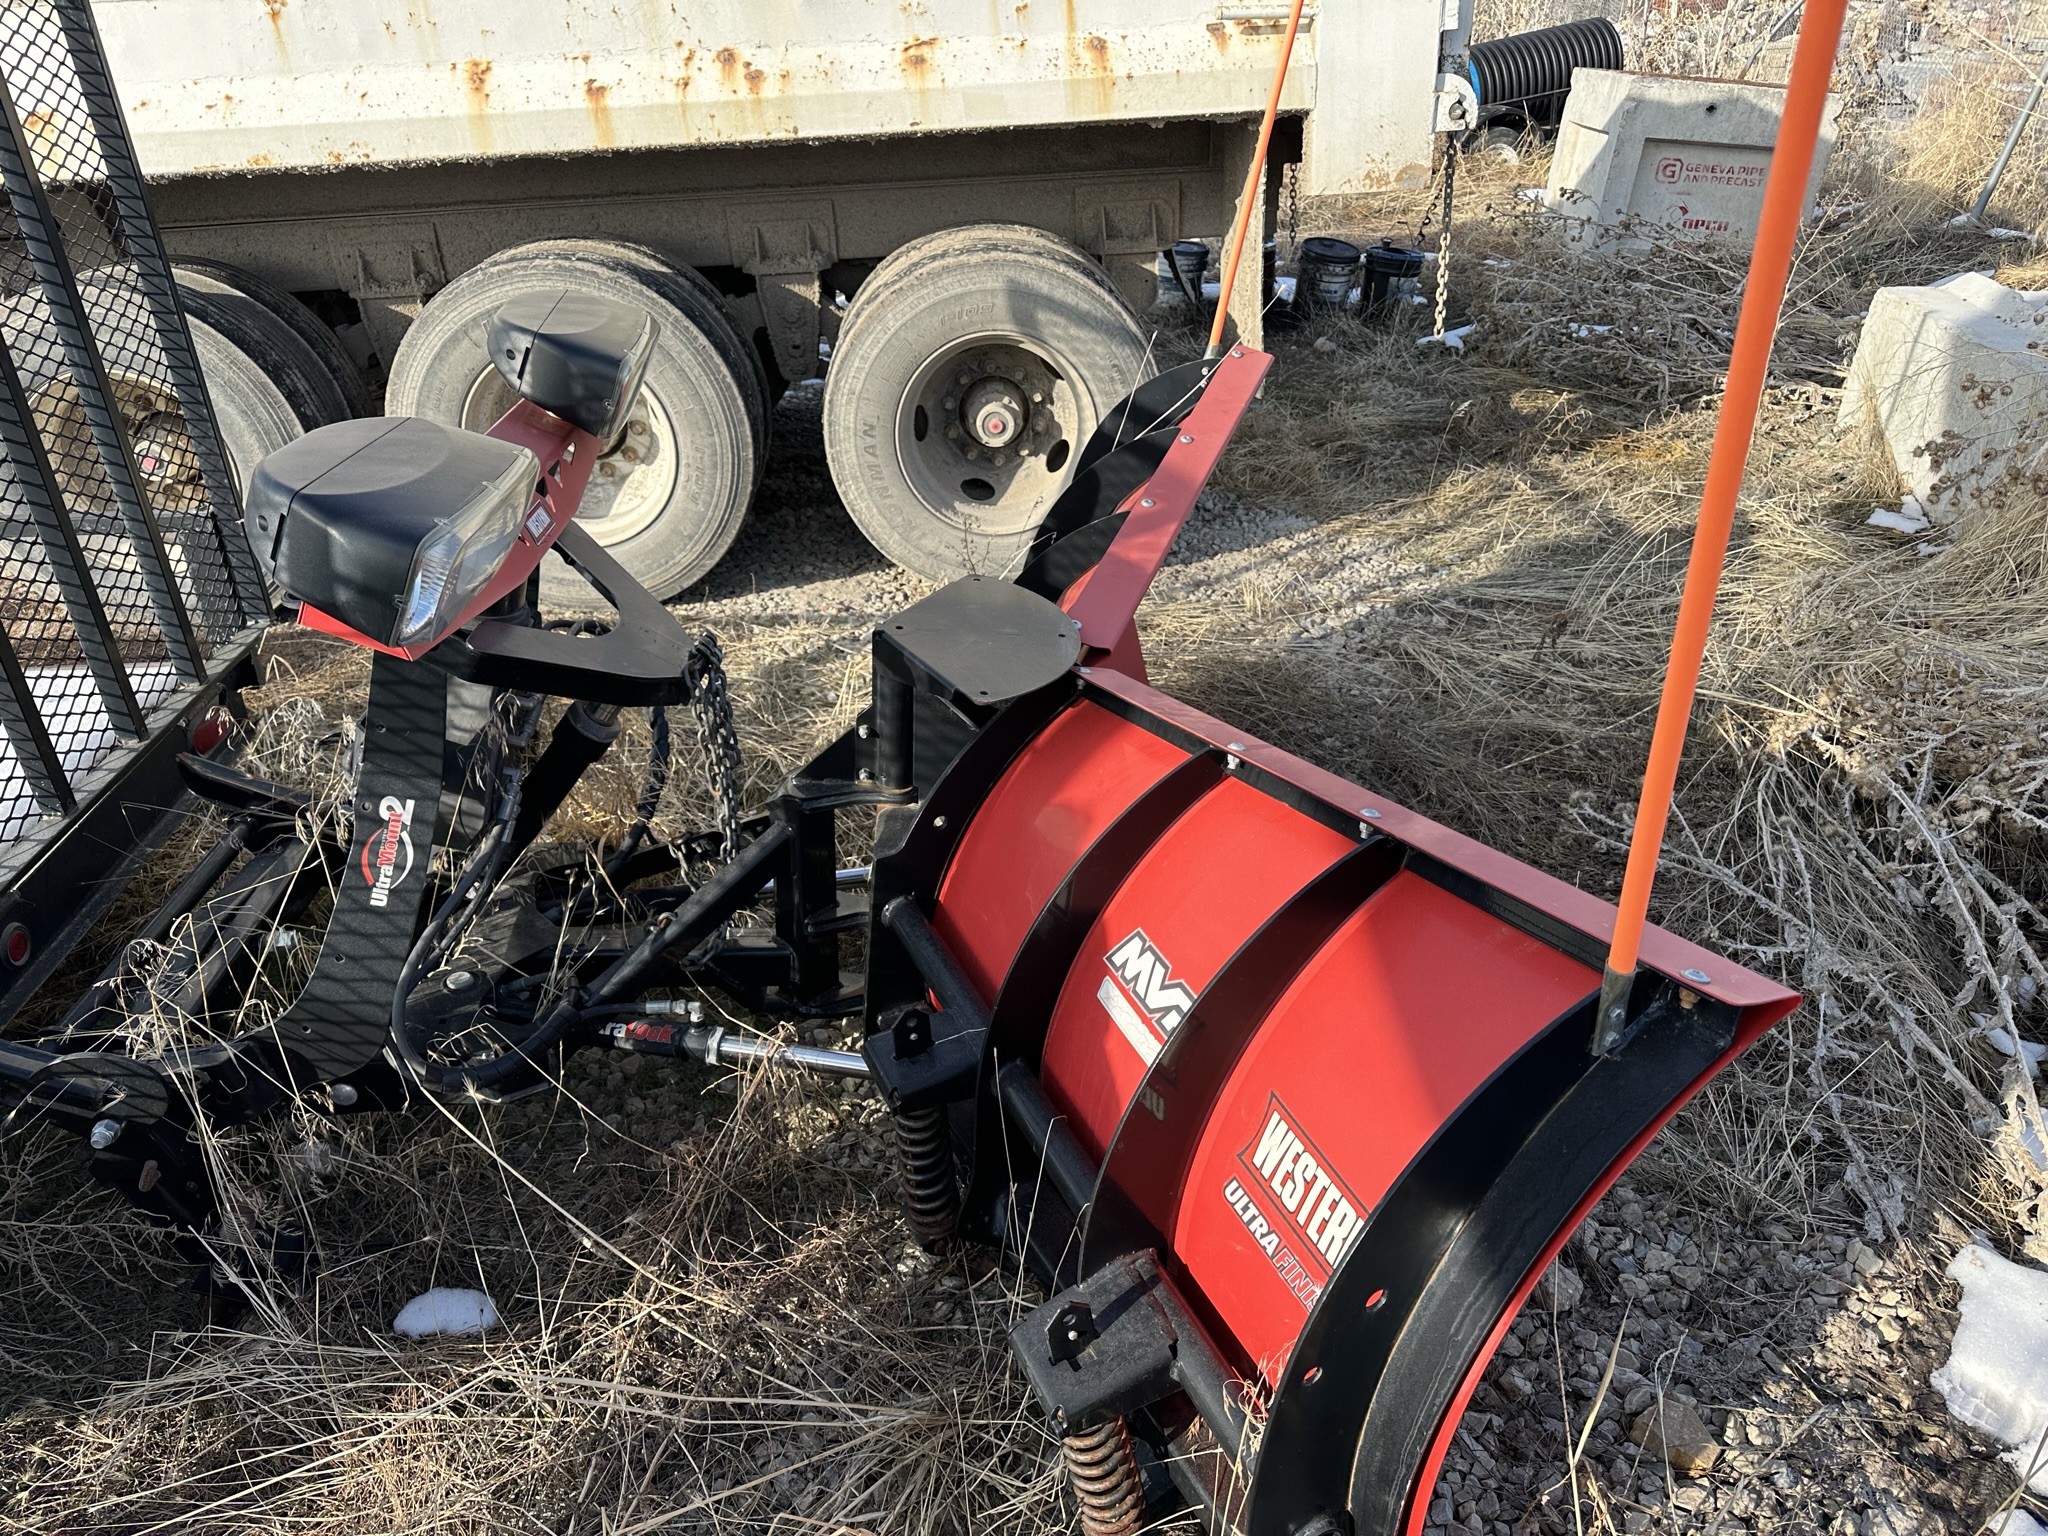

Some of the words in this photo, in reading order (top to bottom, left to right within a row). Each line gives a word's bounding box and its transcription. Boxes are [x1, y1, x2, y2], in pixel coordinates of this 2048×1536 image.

[1683, 174, 1709, 184] AND
[1710, 175, 1764, 188] PRECAST
[1685, 162, 1735, 176] GENEVA
[1738, 166, 1767, 176] PIPE
[369, 812, 404, 908] UltraMount
[1223, 1178, 1279, 1262] ULTRA
